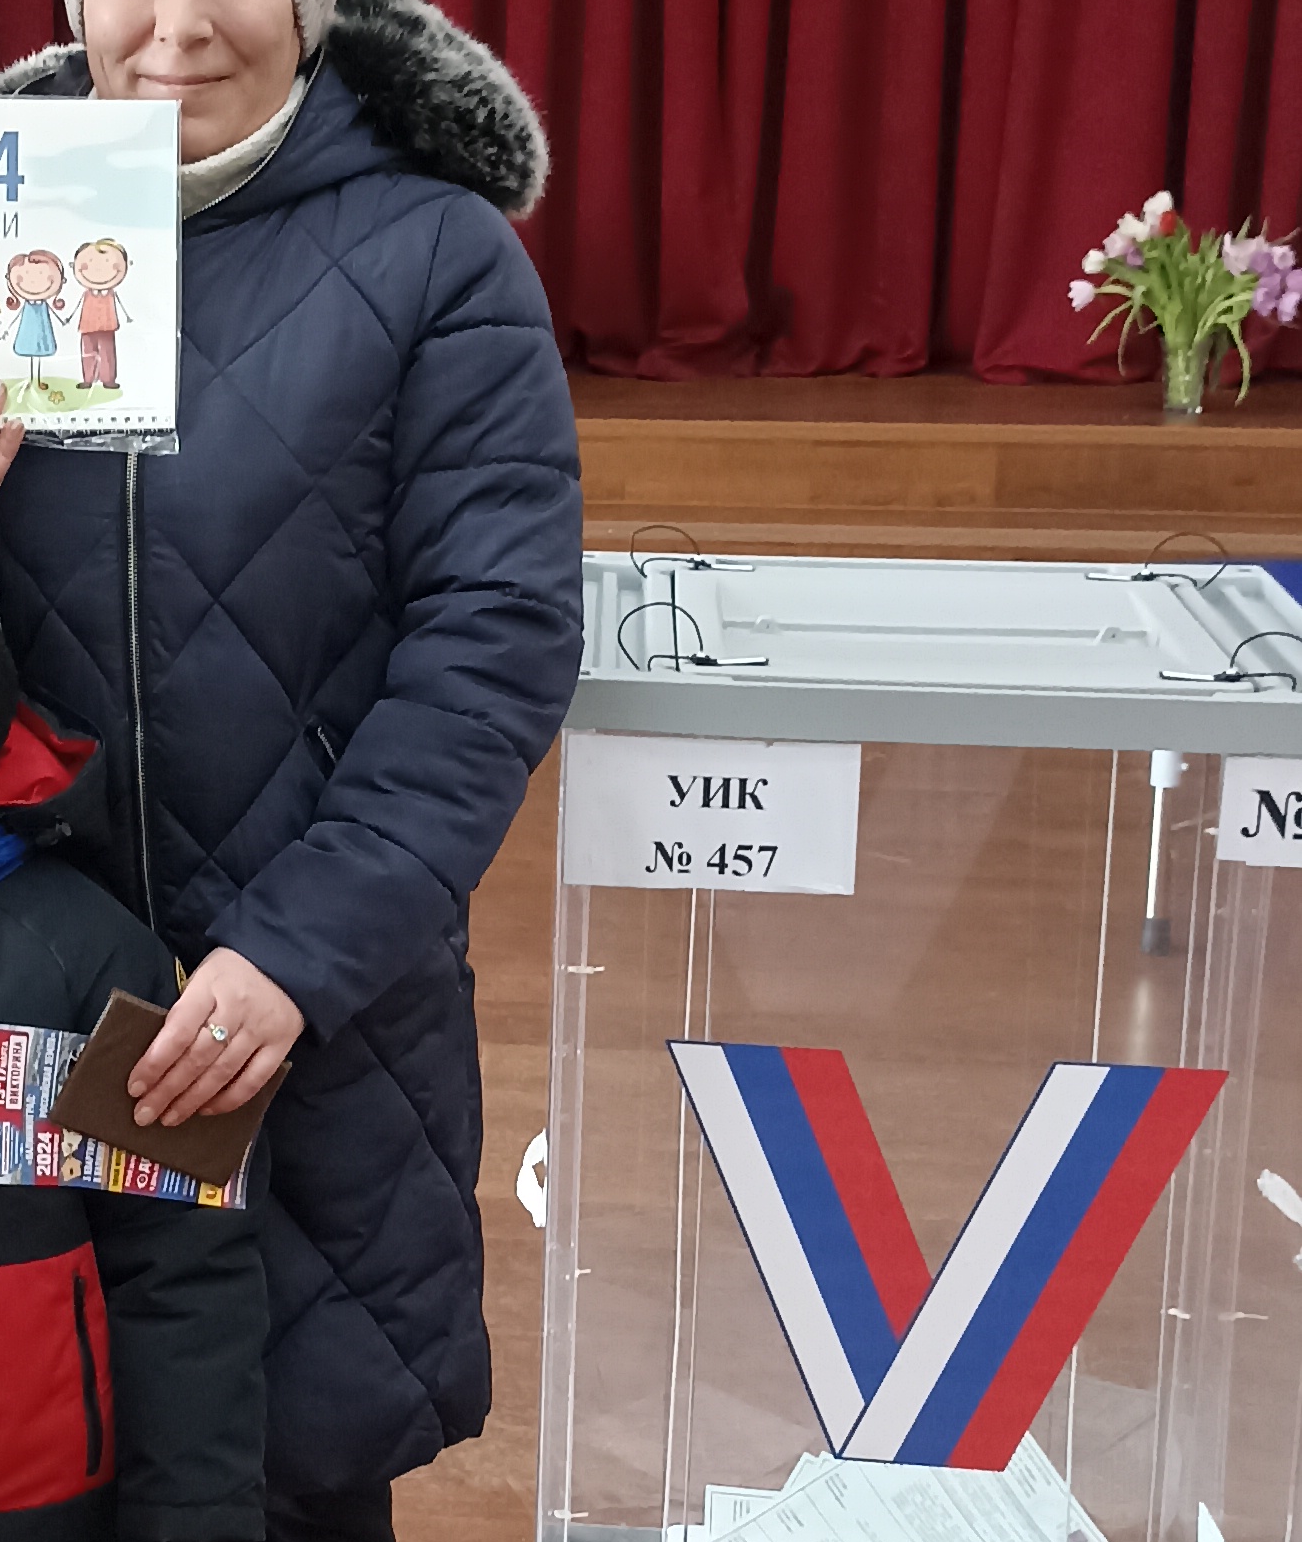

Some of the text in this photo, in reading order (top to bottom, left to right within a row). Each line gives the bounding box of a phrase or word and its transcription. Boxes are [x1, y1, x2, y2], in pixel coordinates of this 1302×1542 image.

[667, 774, 769, 811] УИК
[644, 840, 779, 878] № 457
[36, 1131, 53, 1176] 2024
